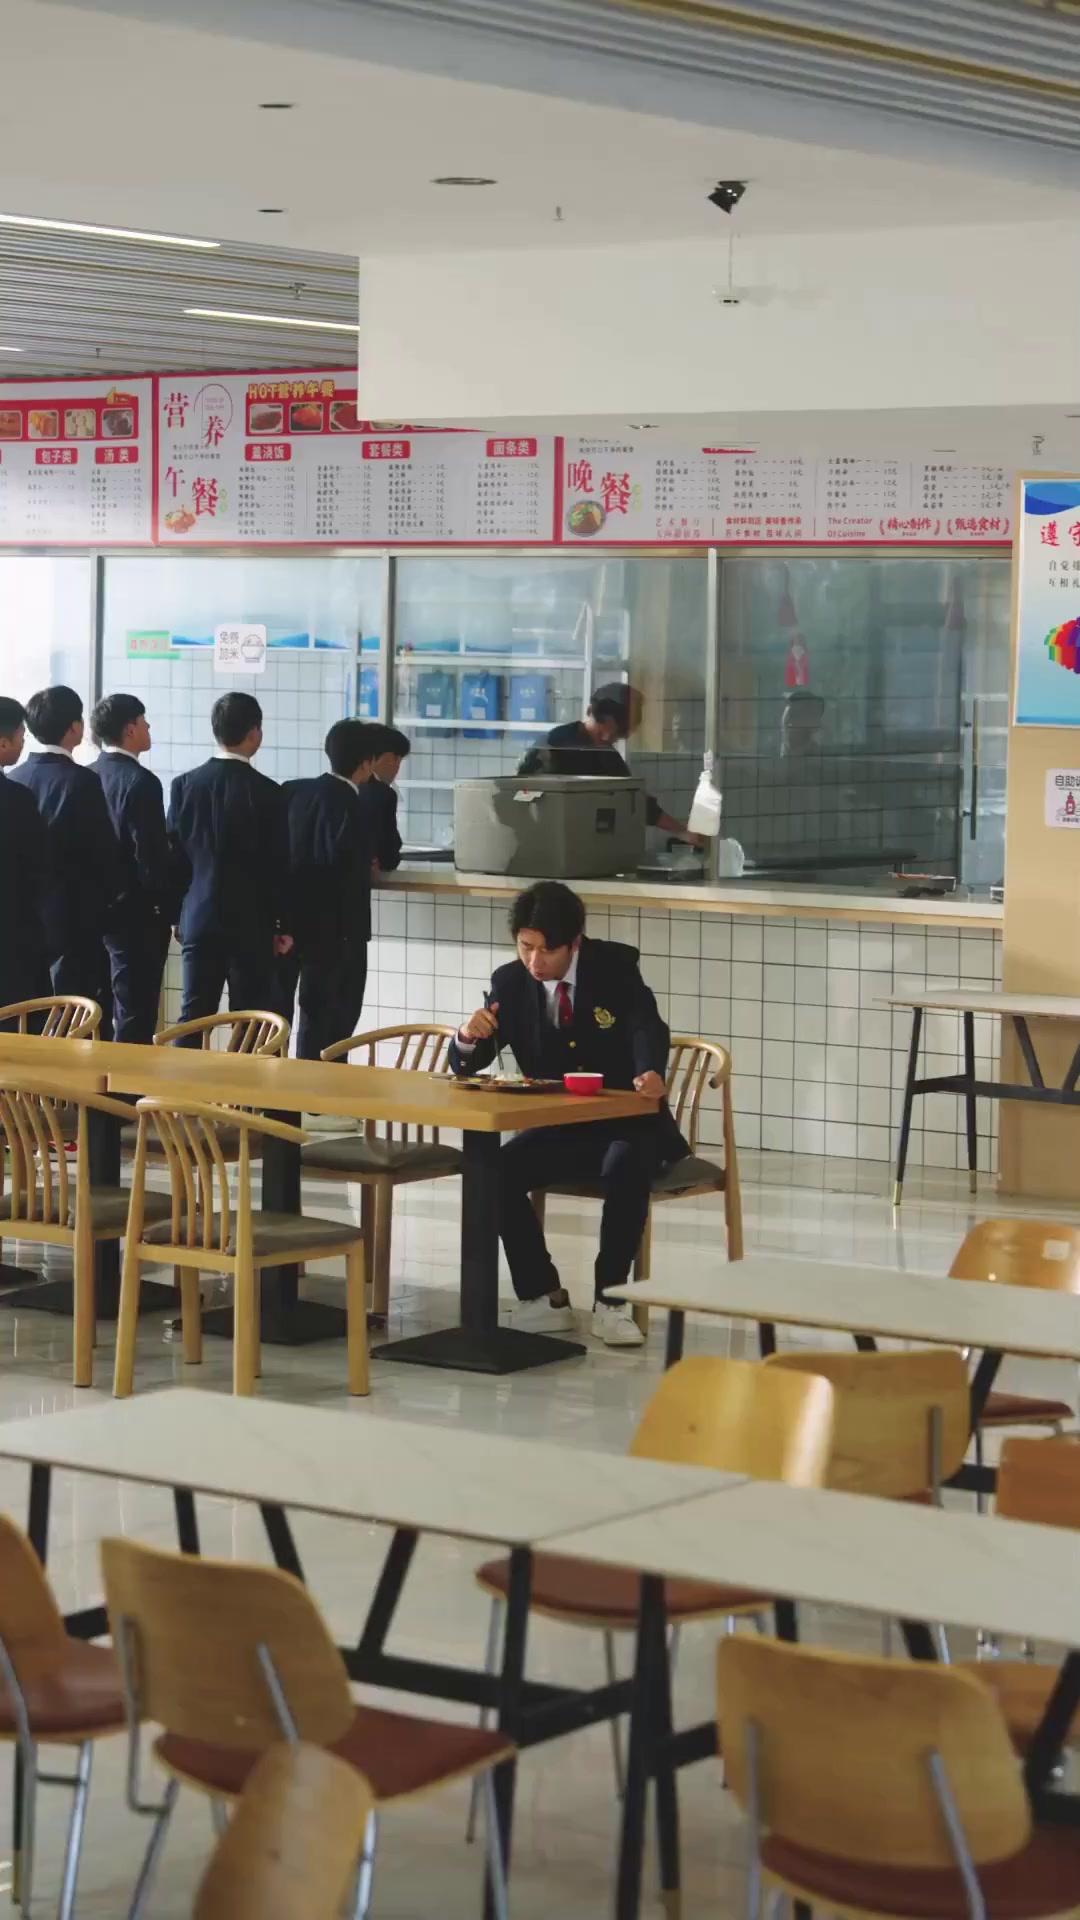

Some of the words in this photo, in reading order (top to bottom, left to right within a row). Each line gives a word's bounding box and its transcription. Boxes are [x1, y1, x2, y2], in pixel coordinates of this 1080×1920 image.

[250, 446, 284, 460] 盖浇饭
[368, 443, 404, 457] 套餐类
[493, 440, 530, 455] 面条类
[42, 450, 72, 464] 包子类
[567, 459, 632, 514] 晚餐
[827, 517, 841, 525] The
[843, 517, 873, 525] Creator
[887, 517, 931, 531] 精心制作
[955, 517, 1000, 531] 甄选食材
[220, 631, 239, 645] 免费
